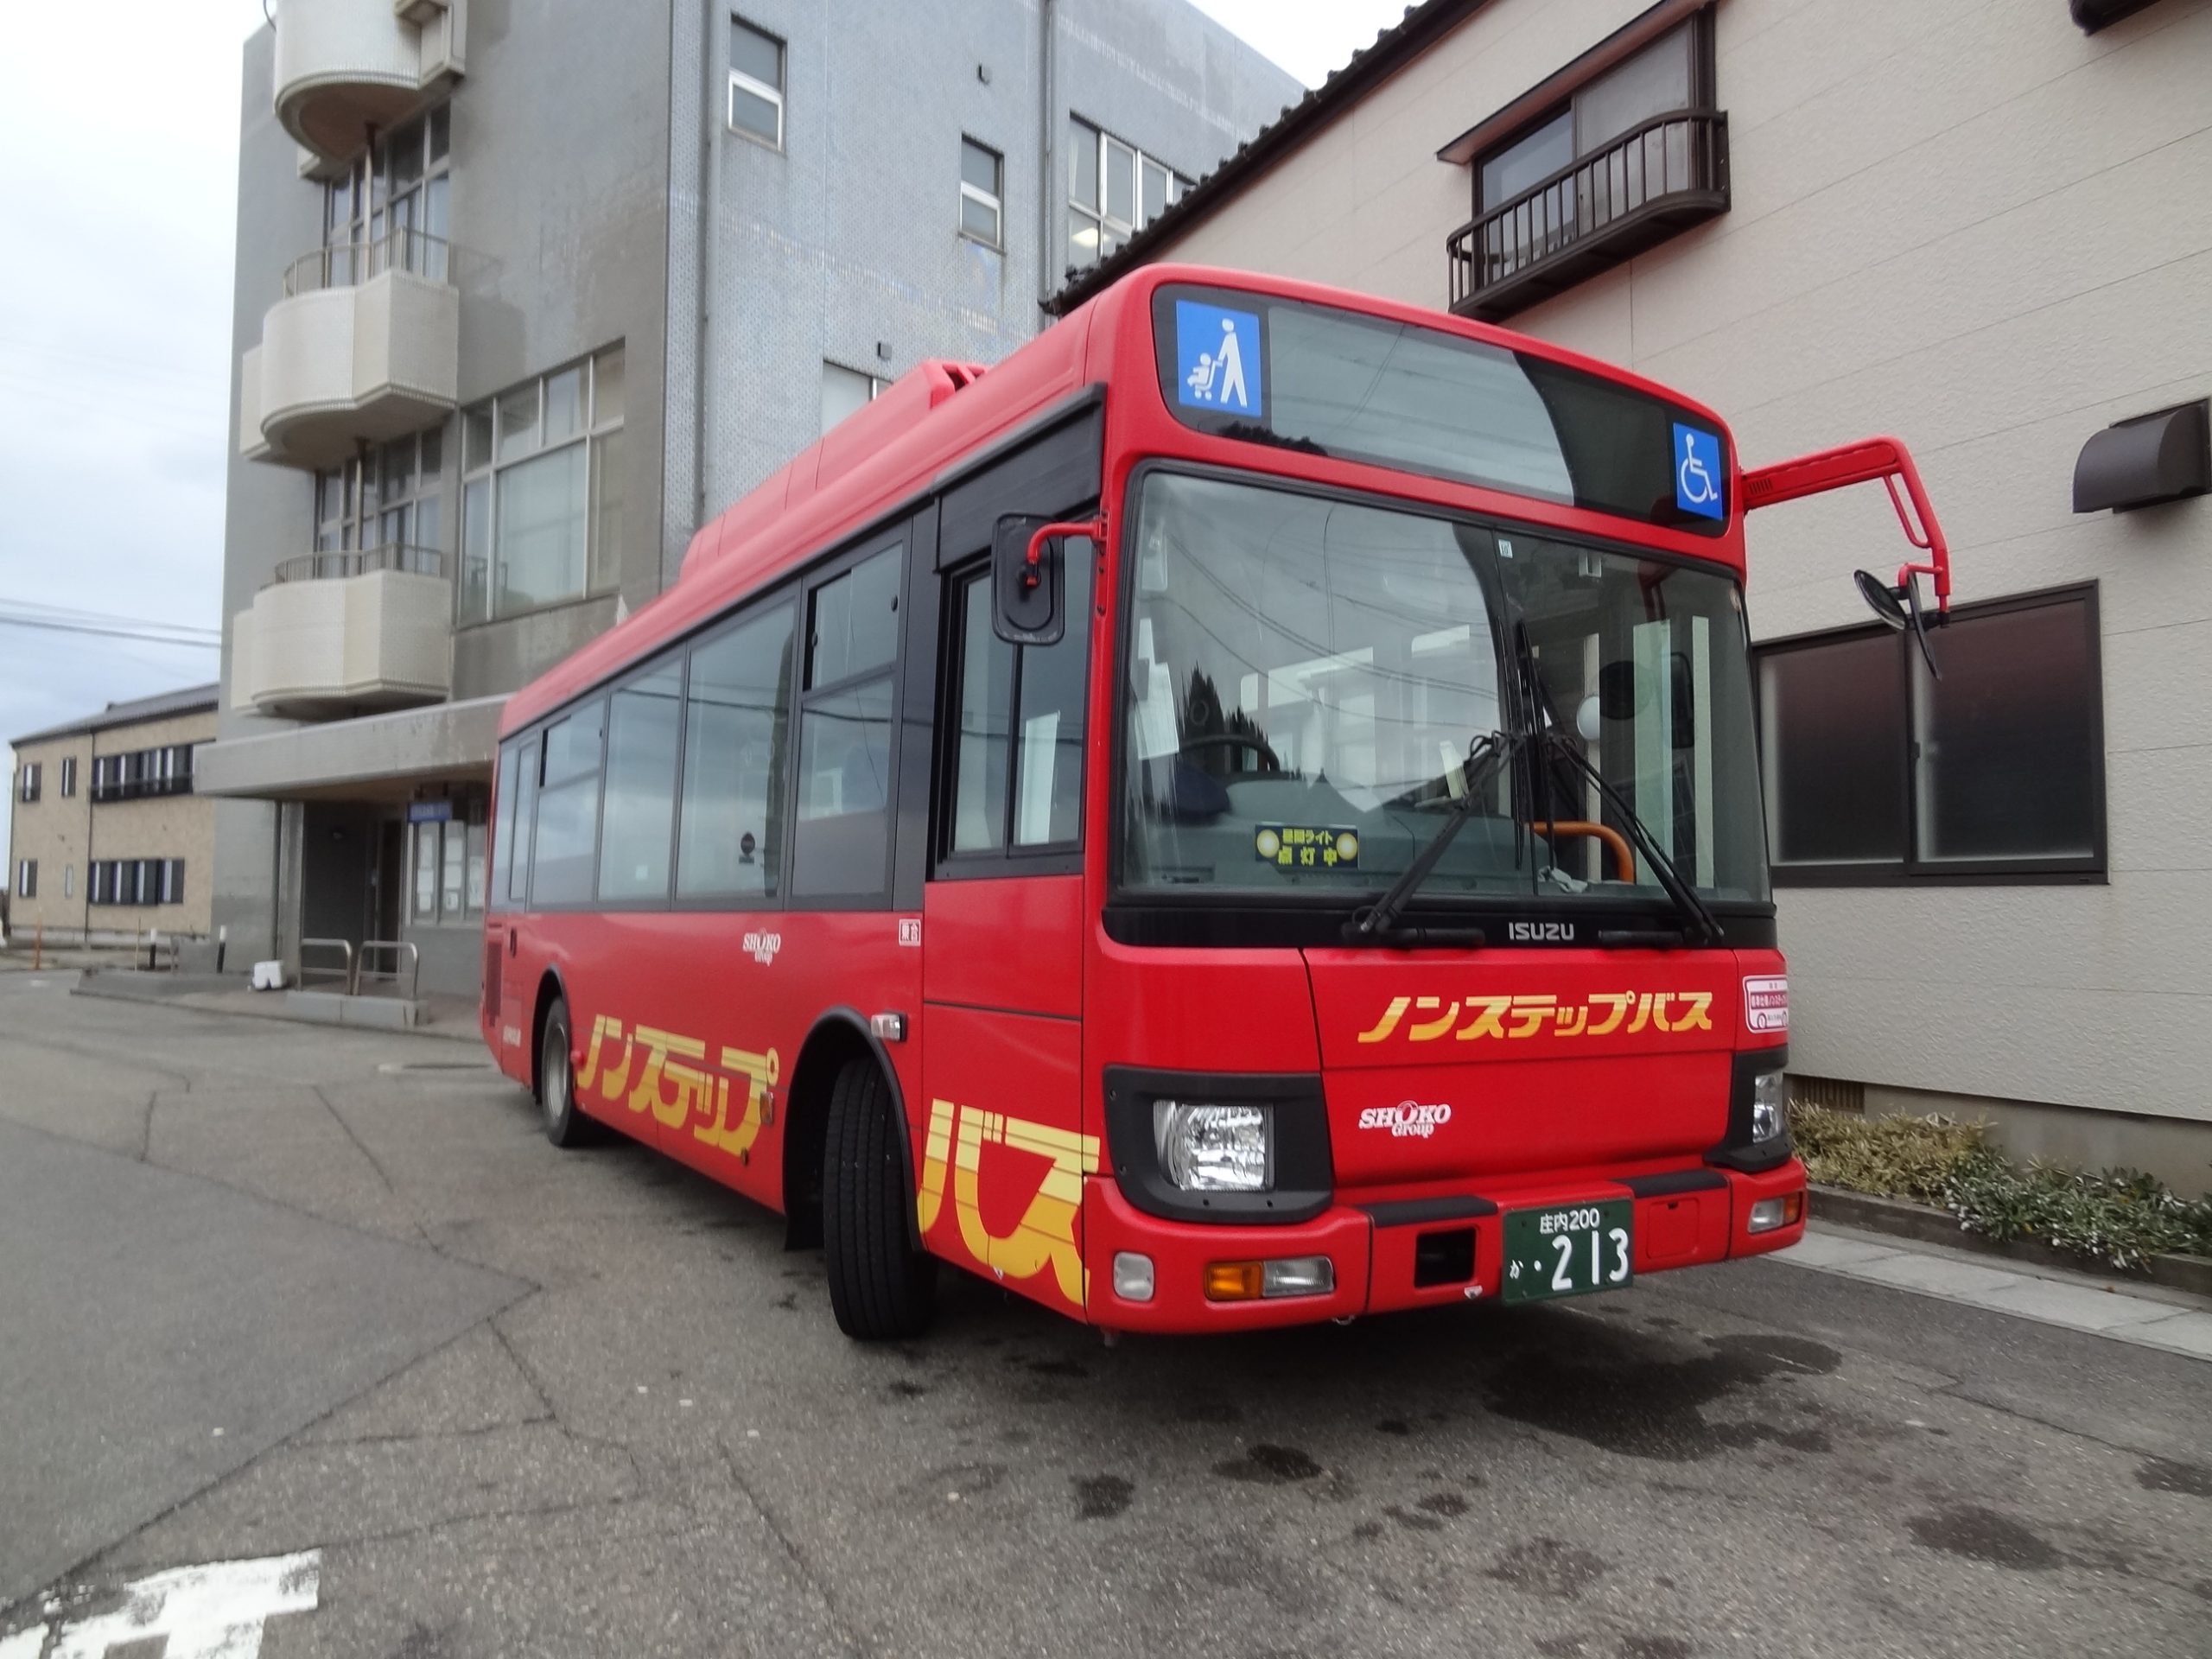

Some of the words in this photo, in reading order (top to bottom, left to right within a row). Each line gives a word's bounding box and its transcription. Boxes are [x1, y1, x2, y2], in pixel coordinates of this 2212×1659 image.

[743, 928, 781, 954] SHOKO
[1509, 922, 1574, 941] ISUZU
[1357, 990, 1713, 1043] ノンステップバス
[1358, 1100, 1452, 1129] SHOKO
[1391, 1122, 1434, 1139] Group
[576, 1014, 779, 1159] ノンステップ
[917, 1098, 1101, 1311] バス
